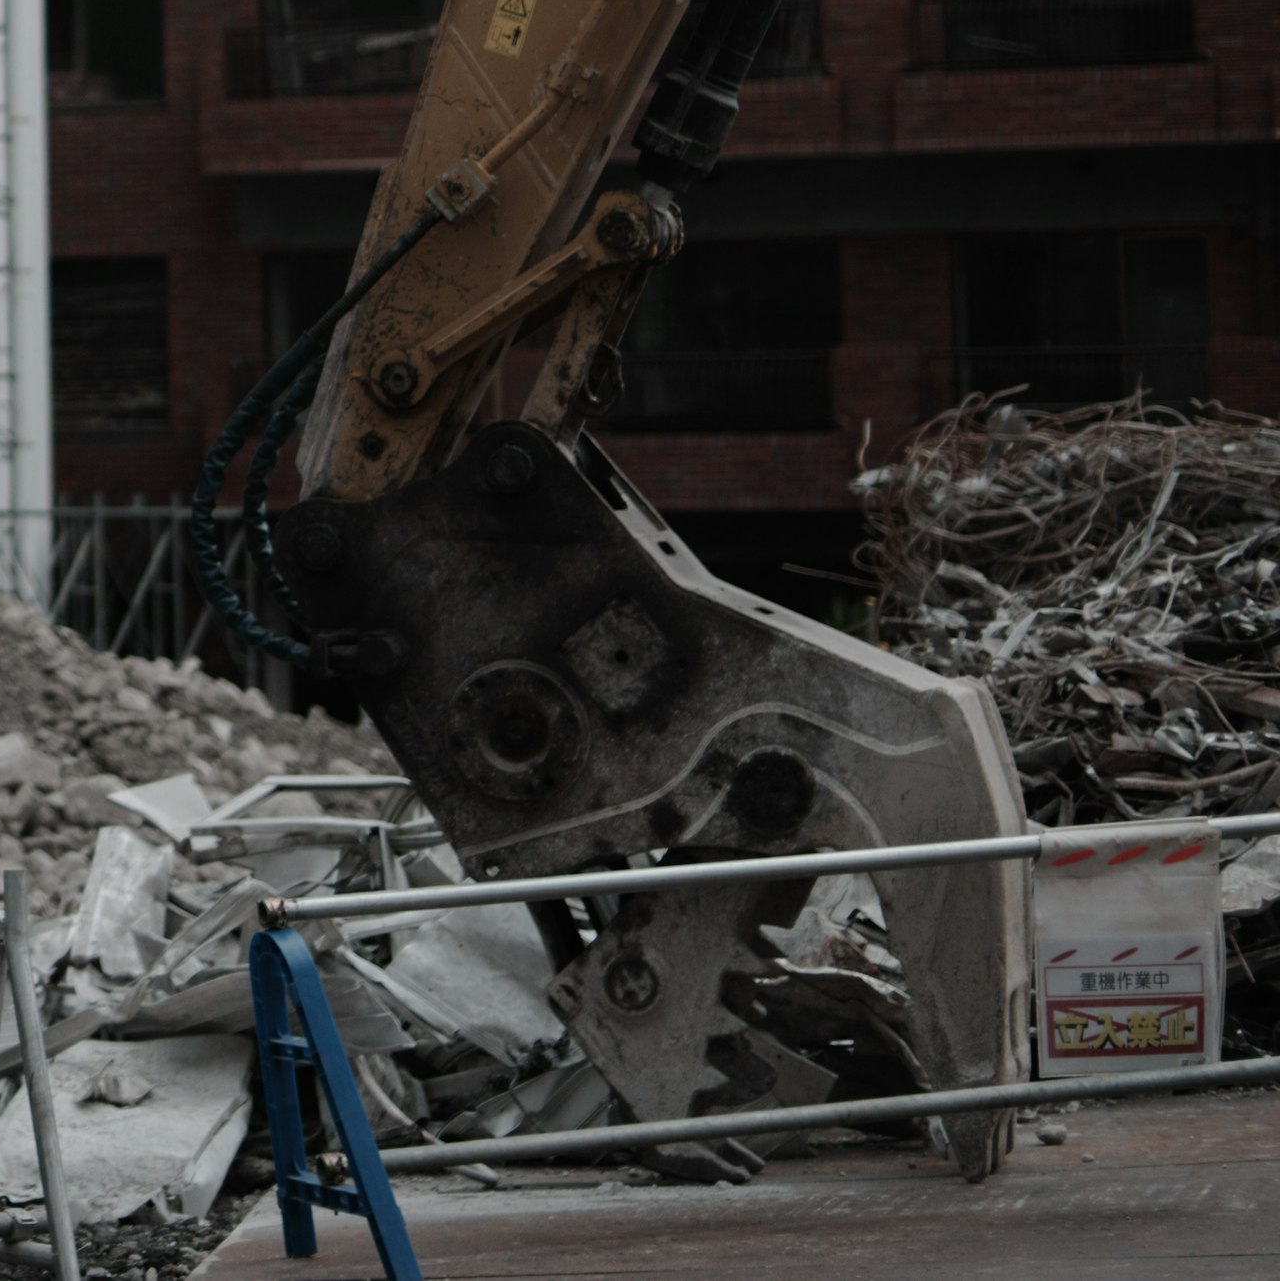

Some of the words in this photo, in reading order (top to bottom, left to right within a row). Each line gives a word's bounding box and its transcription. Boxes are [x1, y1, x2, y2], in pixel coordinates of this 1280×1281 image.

[1080, 971, 1170, 992] 重機作業中
[1055, 1009, 1197, 1050] 立入禁止
